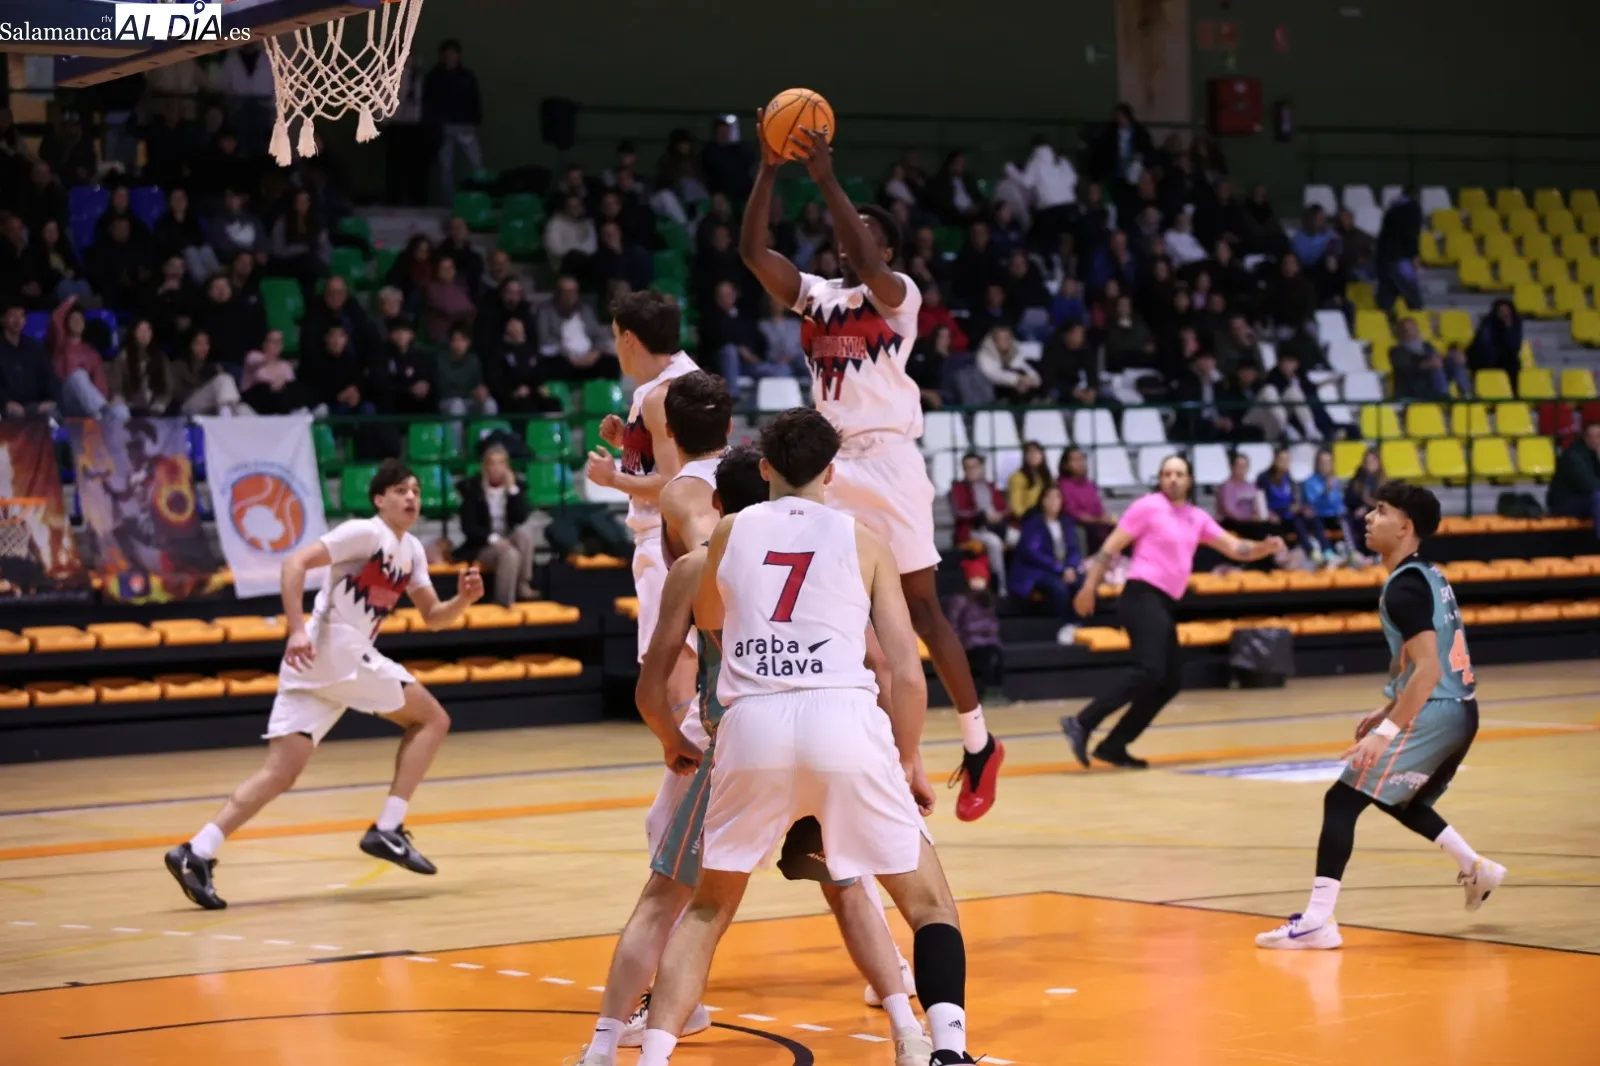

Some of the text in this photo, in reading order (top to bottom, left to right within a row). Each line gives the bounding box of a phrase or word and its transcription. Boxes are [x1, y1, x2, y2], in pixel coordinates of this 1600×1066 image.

[762, 550, 816, 623] 7
[734, 634, 799, 657] araba
[1449, 629, 1474, 684] 4
[756, 655, 823, 677] álava
